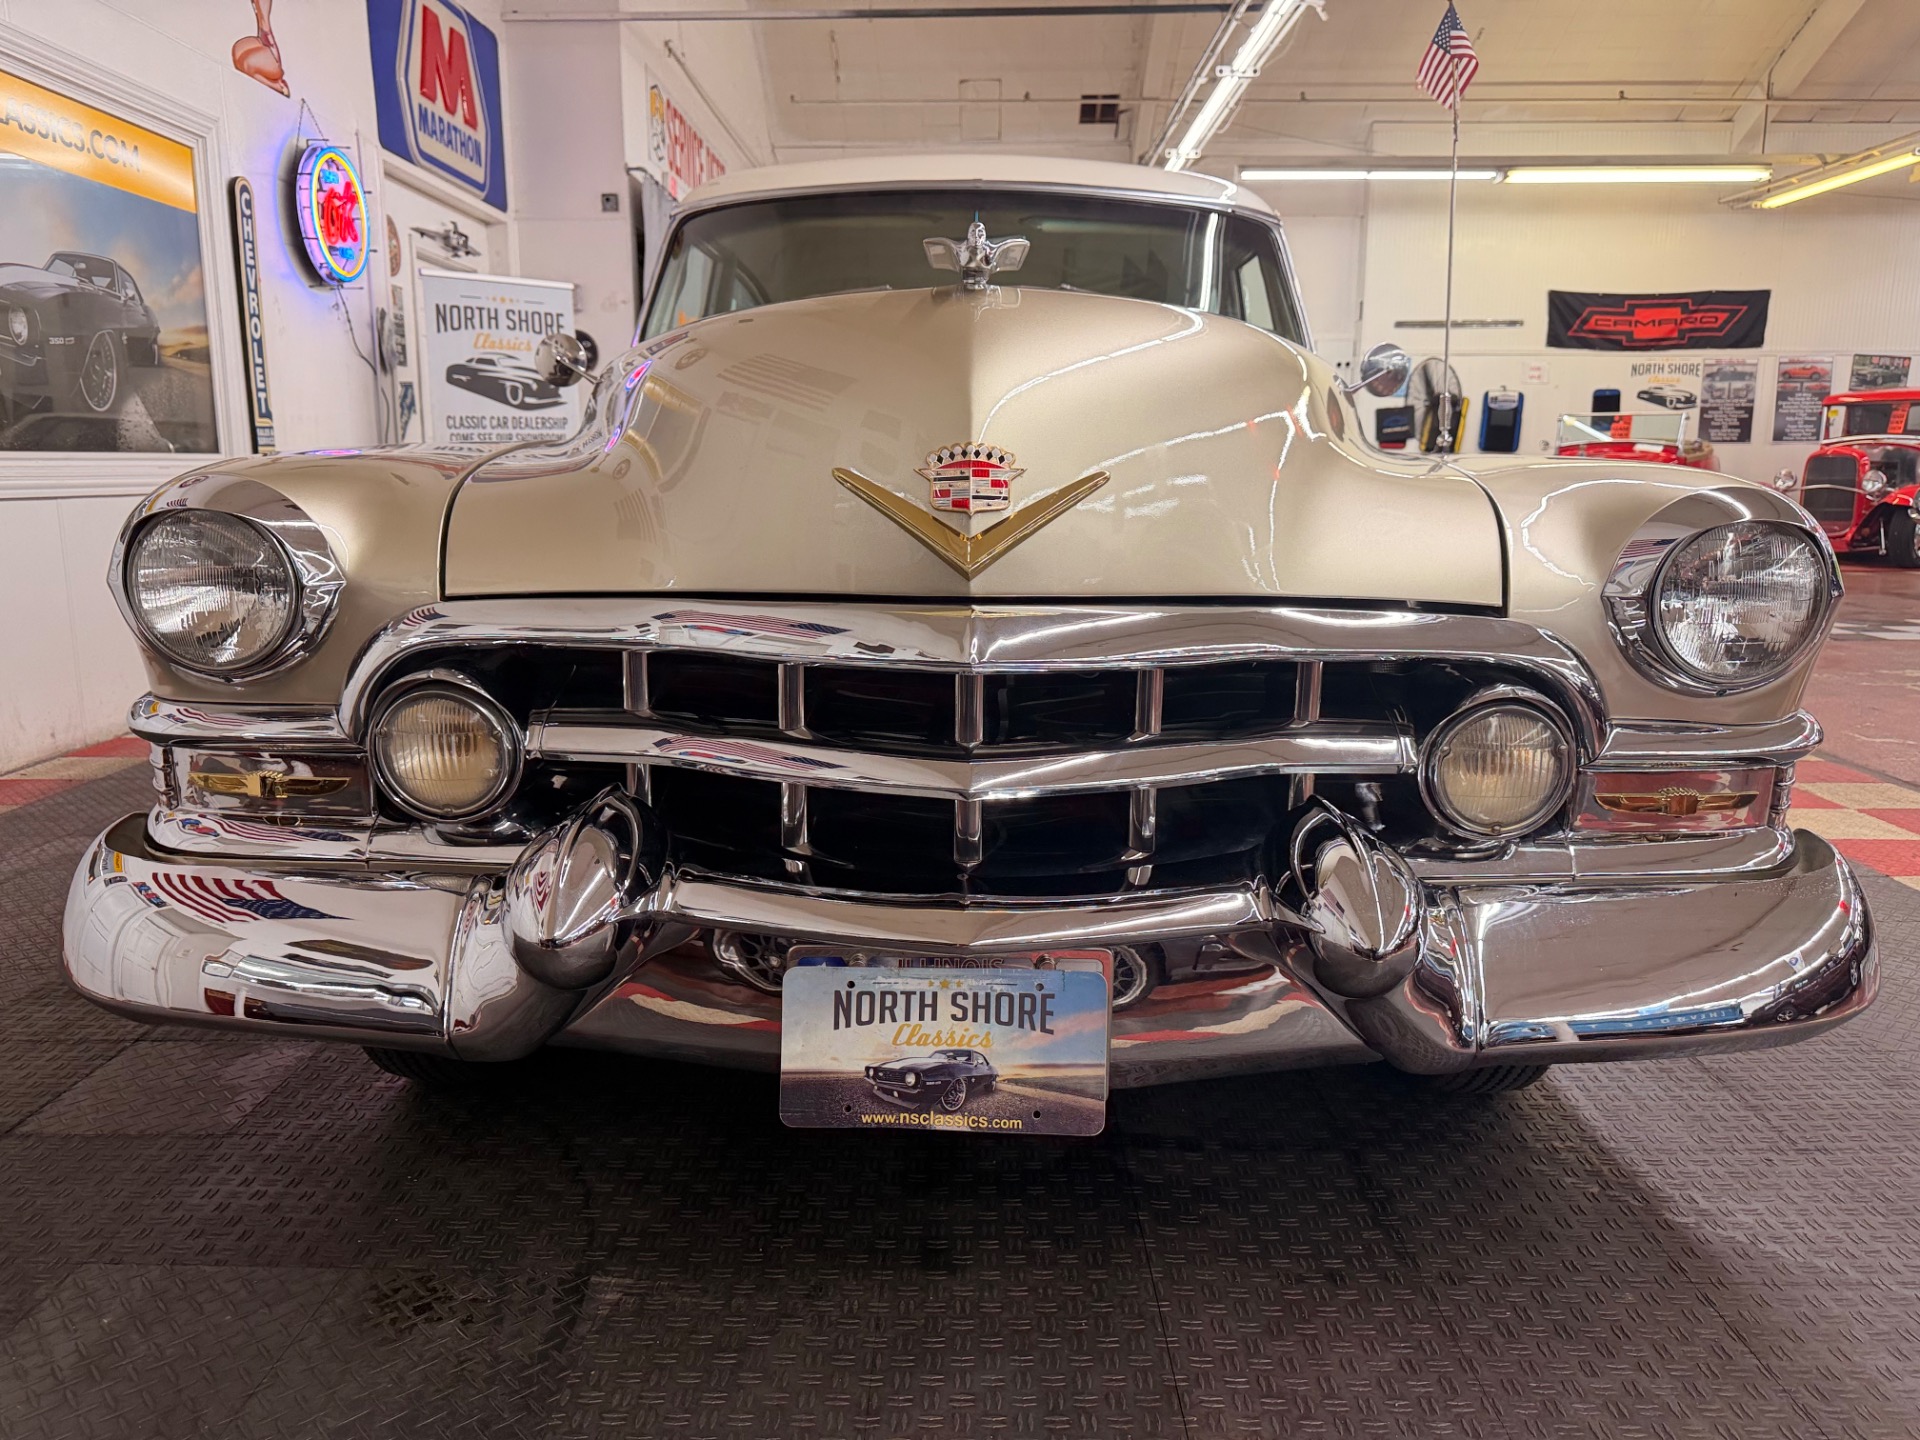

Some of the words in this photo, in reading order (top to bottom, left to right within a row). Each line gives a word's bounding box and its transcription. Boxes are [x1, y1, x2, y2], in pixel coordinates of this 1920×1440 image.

[418, 103, 482, 167] MARATHON
[323, 180, 358, 245] OK
[241, 191, 267, 414] CHEVROLET
[435, 303, 500, 334] NORTH
[505, 309, 565, 336] SHORE
[1594, 315, 1719, 328] CAMARO
[473, 332, 533, 352] Classics
[1631, 363, 1665, 377] NORTH
[1667, 363, 1701, 378] SHORE
[446, 415, 488, 430] CLASSIC
[490, 416, 510, 430] CAR
[511, 416, 569, 431] DEALERSHIP
[833, 990, 938, 1030] NORTH
[950, 991, 1055, 1035] SHORE
[891, 1023, 994, 1049] Classics
[861, 1110, 1023, 1130] www.nsclassics.com
